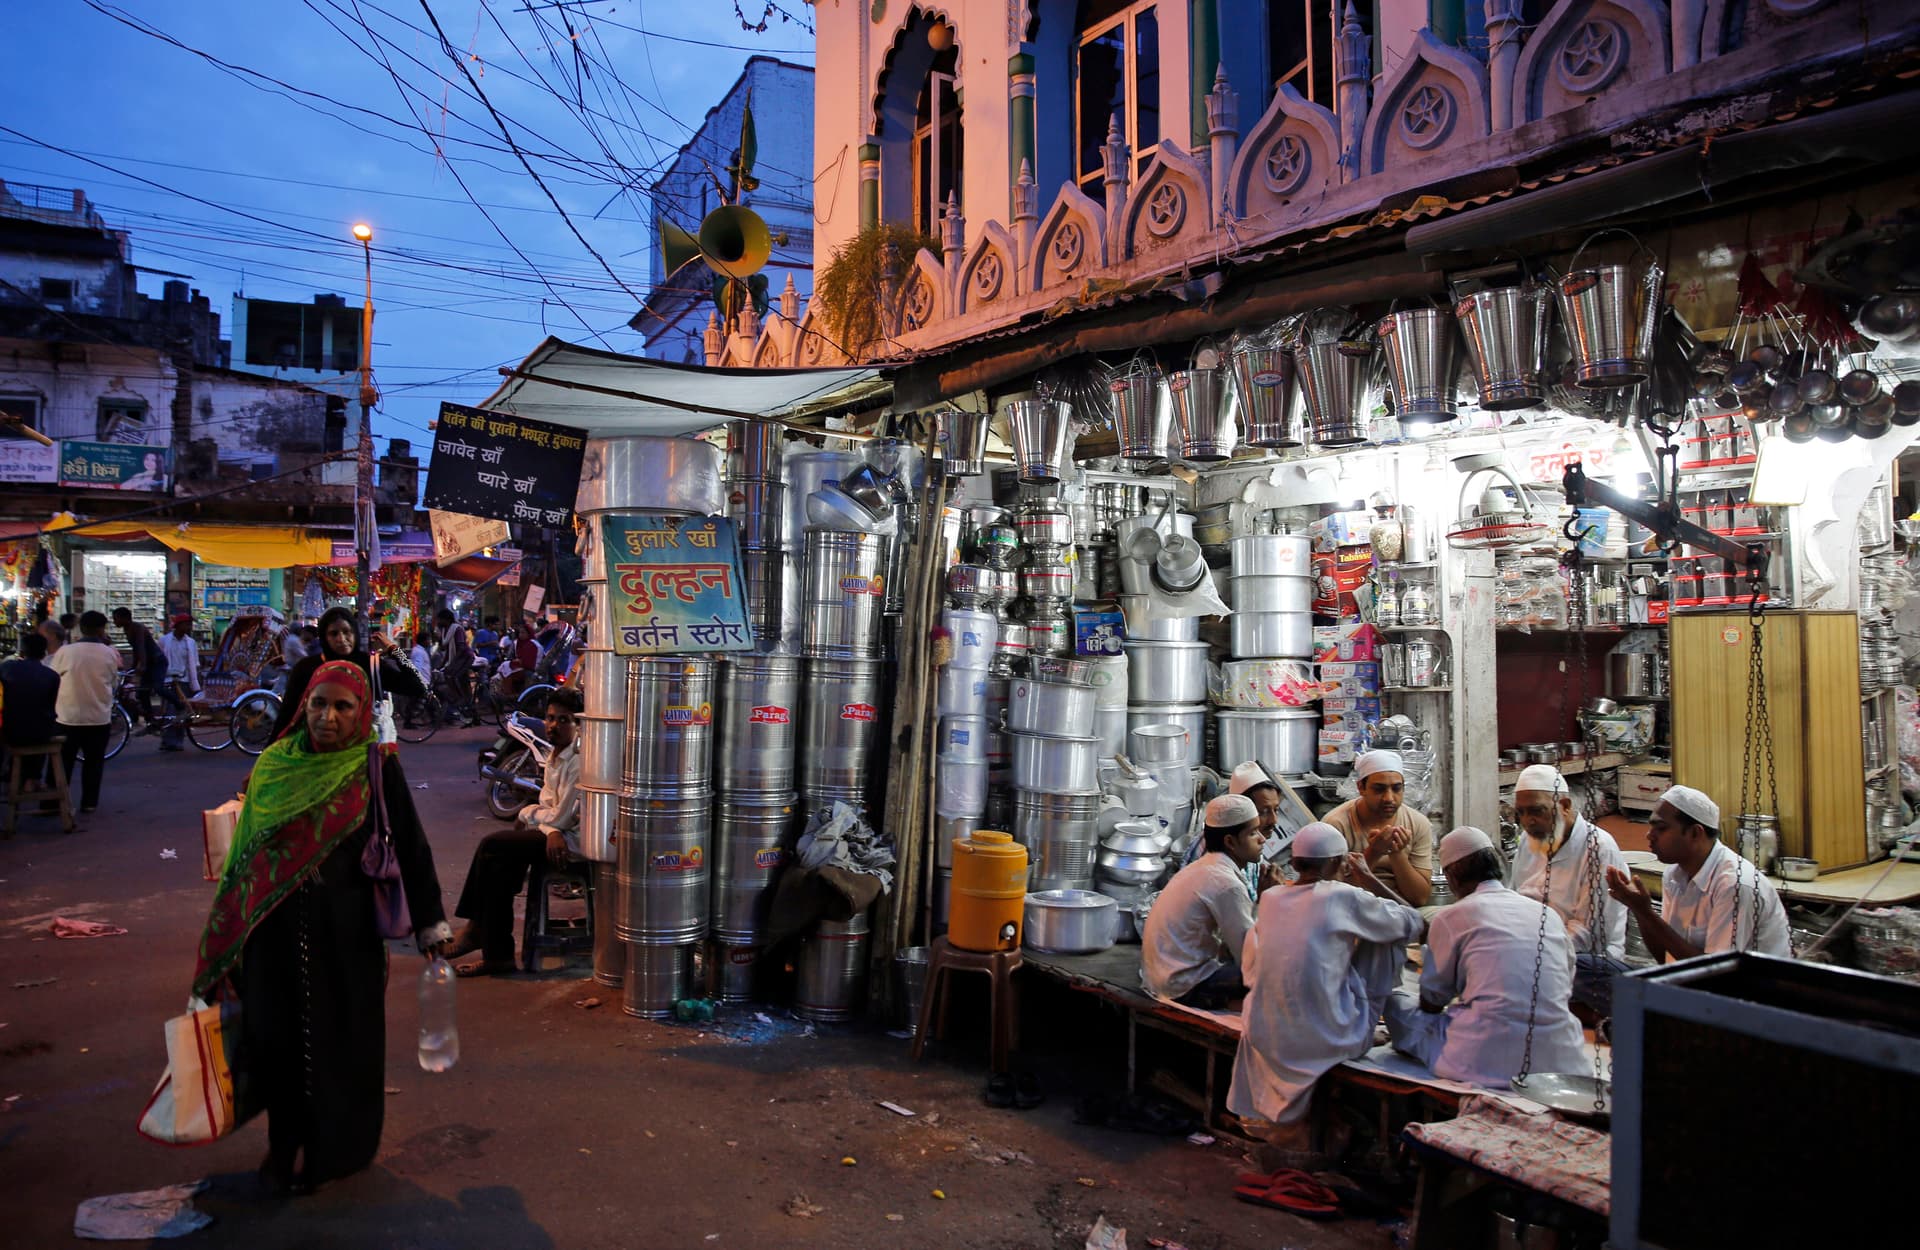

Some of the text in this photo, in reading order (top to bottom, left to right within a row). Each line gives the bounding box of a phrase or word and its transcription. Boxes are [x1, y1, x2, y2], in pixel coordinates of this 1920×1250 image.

[443, 411, 467, 427] बर्तन
[471, 415, 486, 431] की
[488, 421, 518, 437] पुरानी
[438, 438, 505, 465] जावेद खाँ
[91, 461, 120, 478] किंग
[477, 471, 537, 495] प्यारे खाँ
[545, 507, 569, 525] खाँ
[624, 522, 717, 556] दुलारे खाँ
[615, 562, 732, 616] दुल्हन
[620, 615, 744, 647] बर्तन स्टोर
[755, 709, 786, 721] Parag
[847, 706, 873, 717] Para
